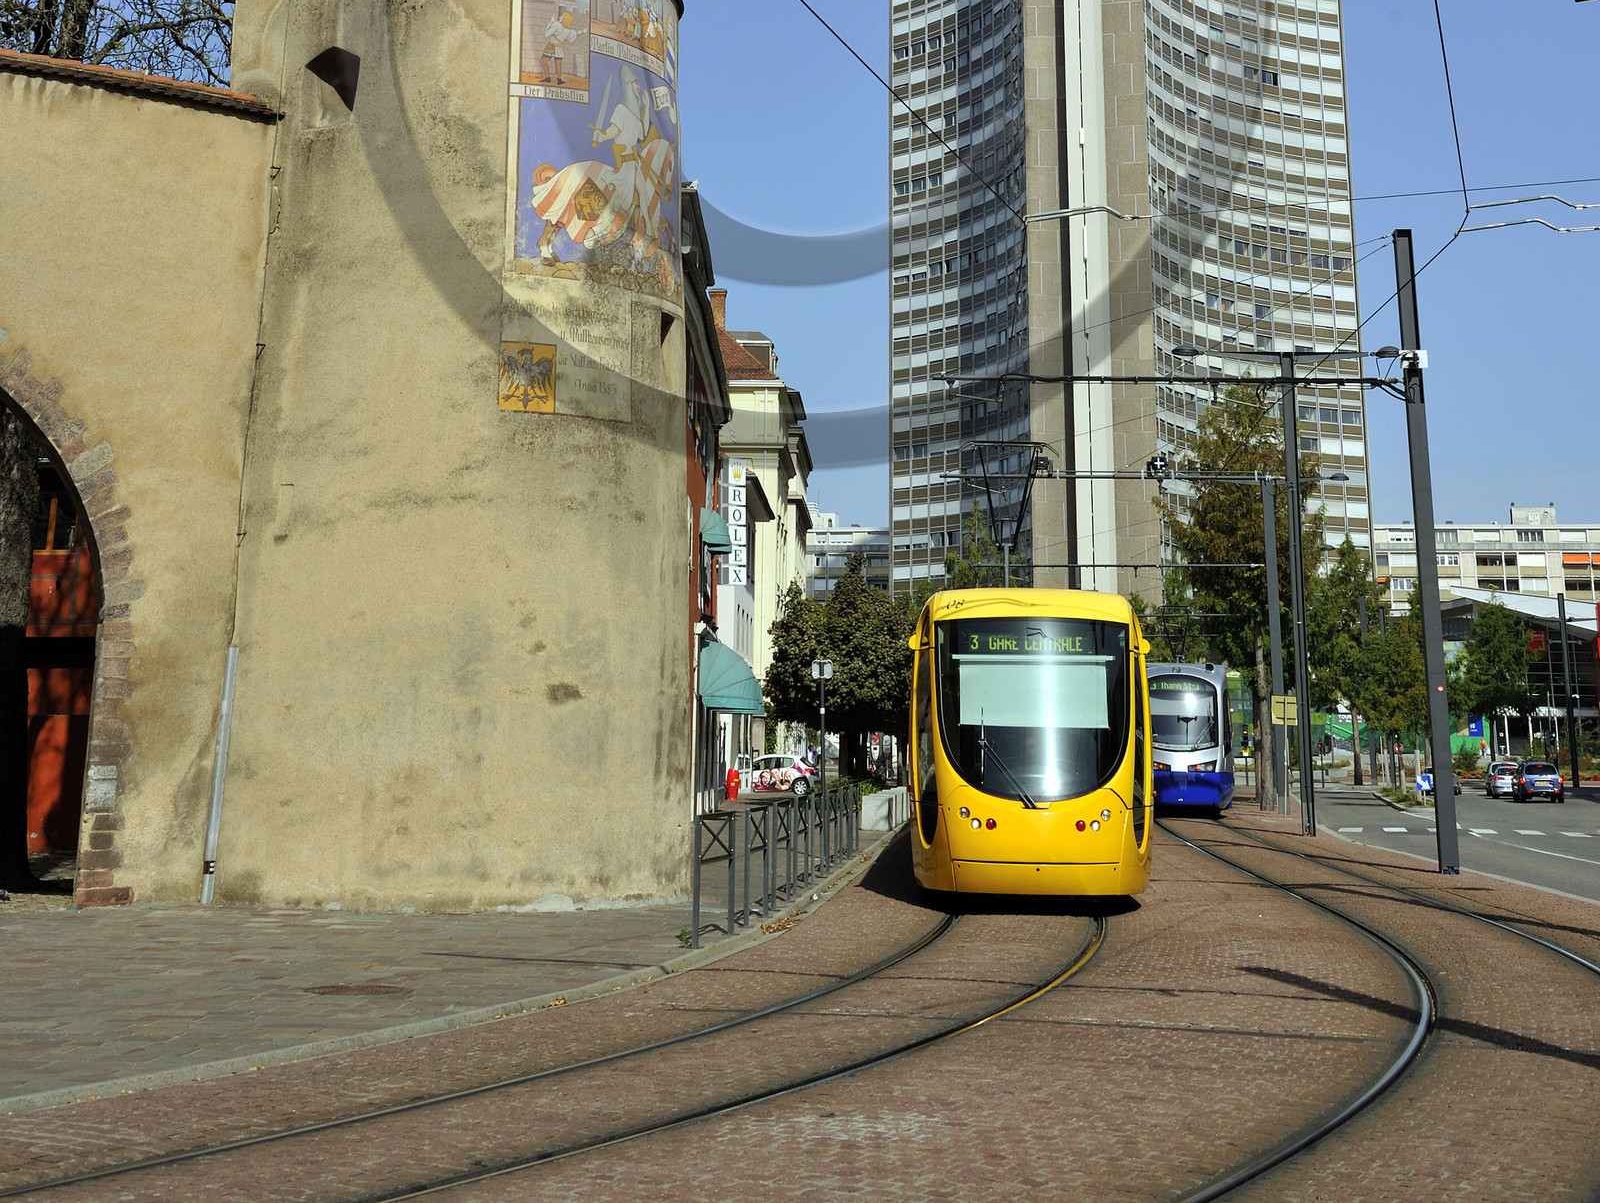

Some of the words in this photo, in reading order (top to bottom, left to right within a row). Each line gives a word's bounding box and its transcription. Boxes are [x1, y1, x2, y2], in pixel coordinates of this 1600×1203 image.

[524, 85, 540, 96] Der
[574, 378, 597, 393] Anno
[732, 489, 743, 583] ROLEX
[970, 635, 979, 650] 3
[989, 636, 1019, 651] GARE
